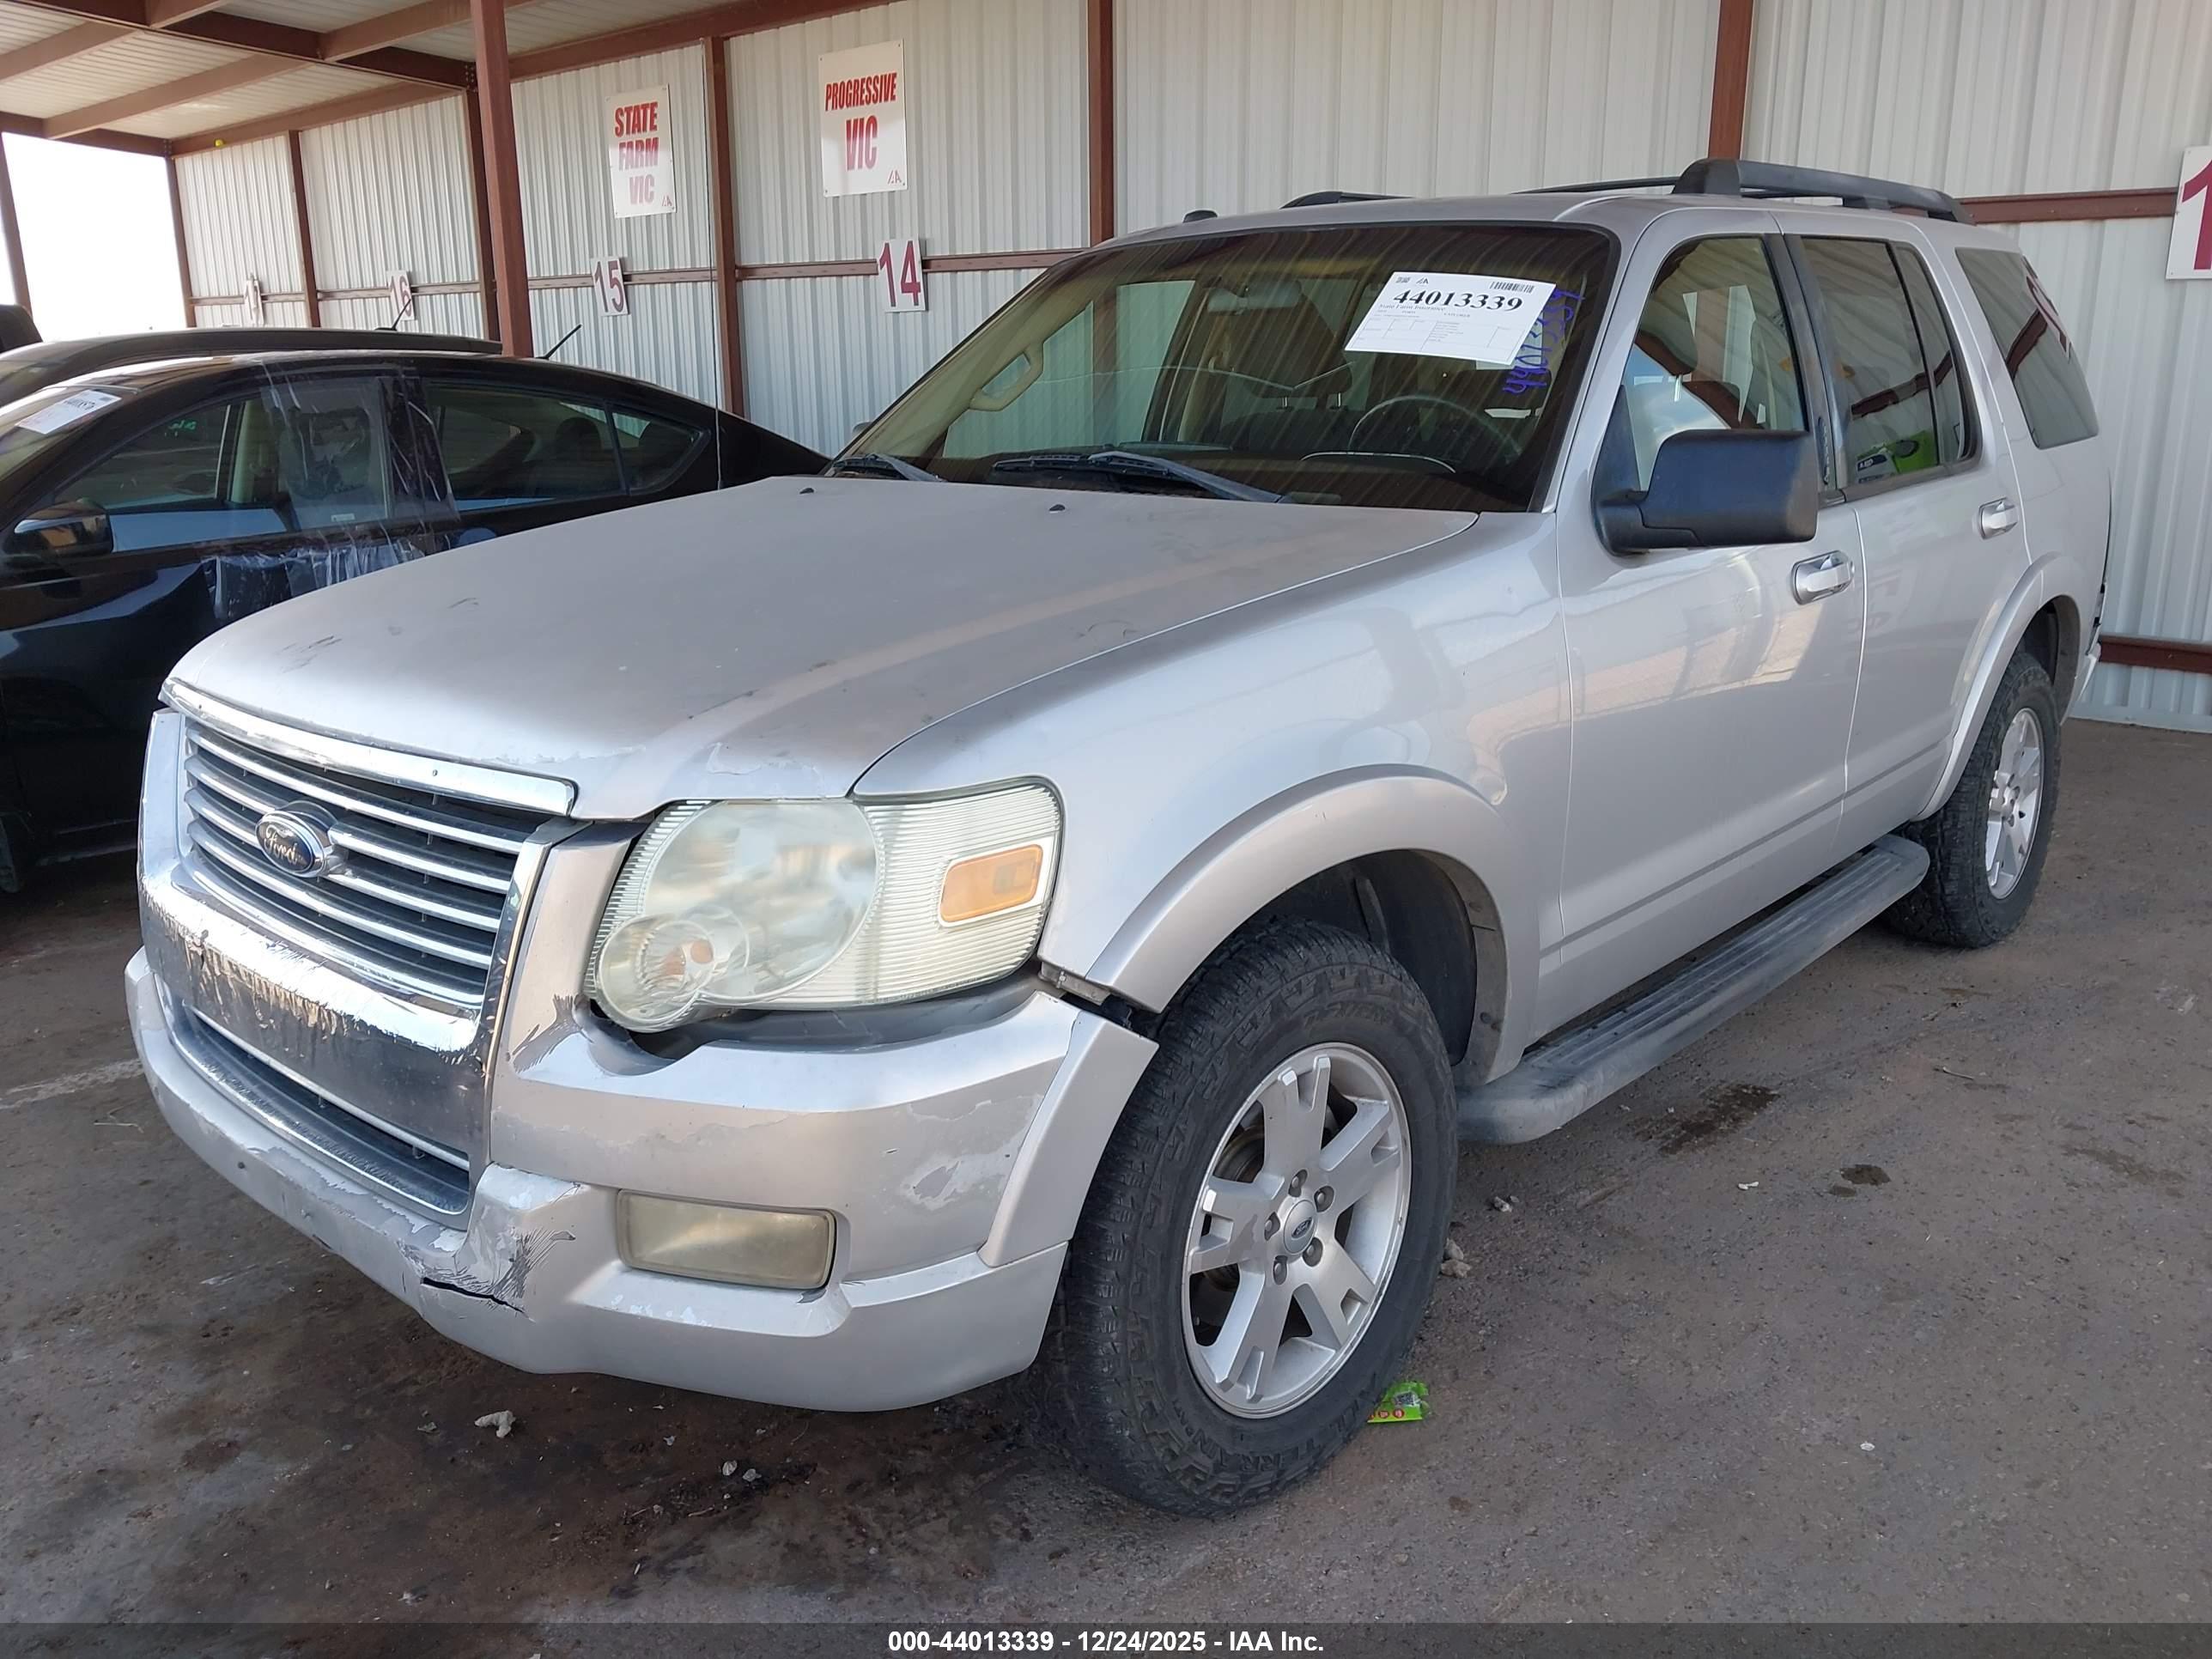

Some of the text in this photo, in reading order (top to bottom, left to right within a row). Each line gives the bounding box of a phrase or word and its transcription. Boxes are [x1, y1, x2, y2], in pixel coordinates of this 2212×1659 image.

[825, 72, 897, 112] PROGRESSIVE
[614, 101, 659, 138] STATE
[618, 137, 659, 171] FARM
[845, 114, 878, 171] VIC
[629, 173, 655, 205] VIC
[594, 259, 624, 313] 15
[878, 240, 922, 307] 14
[390, 275, 412, 317] 16
[1393, 289, 1523, 313] 44013339
[263, 823, 298, 866] Ford
